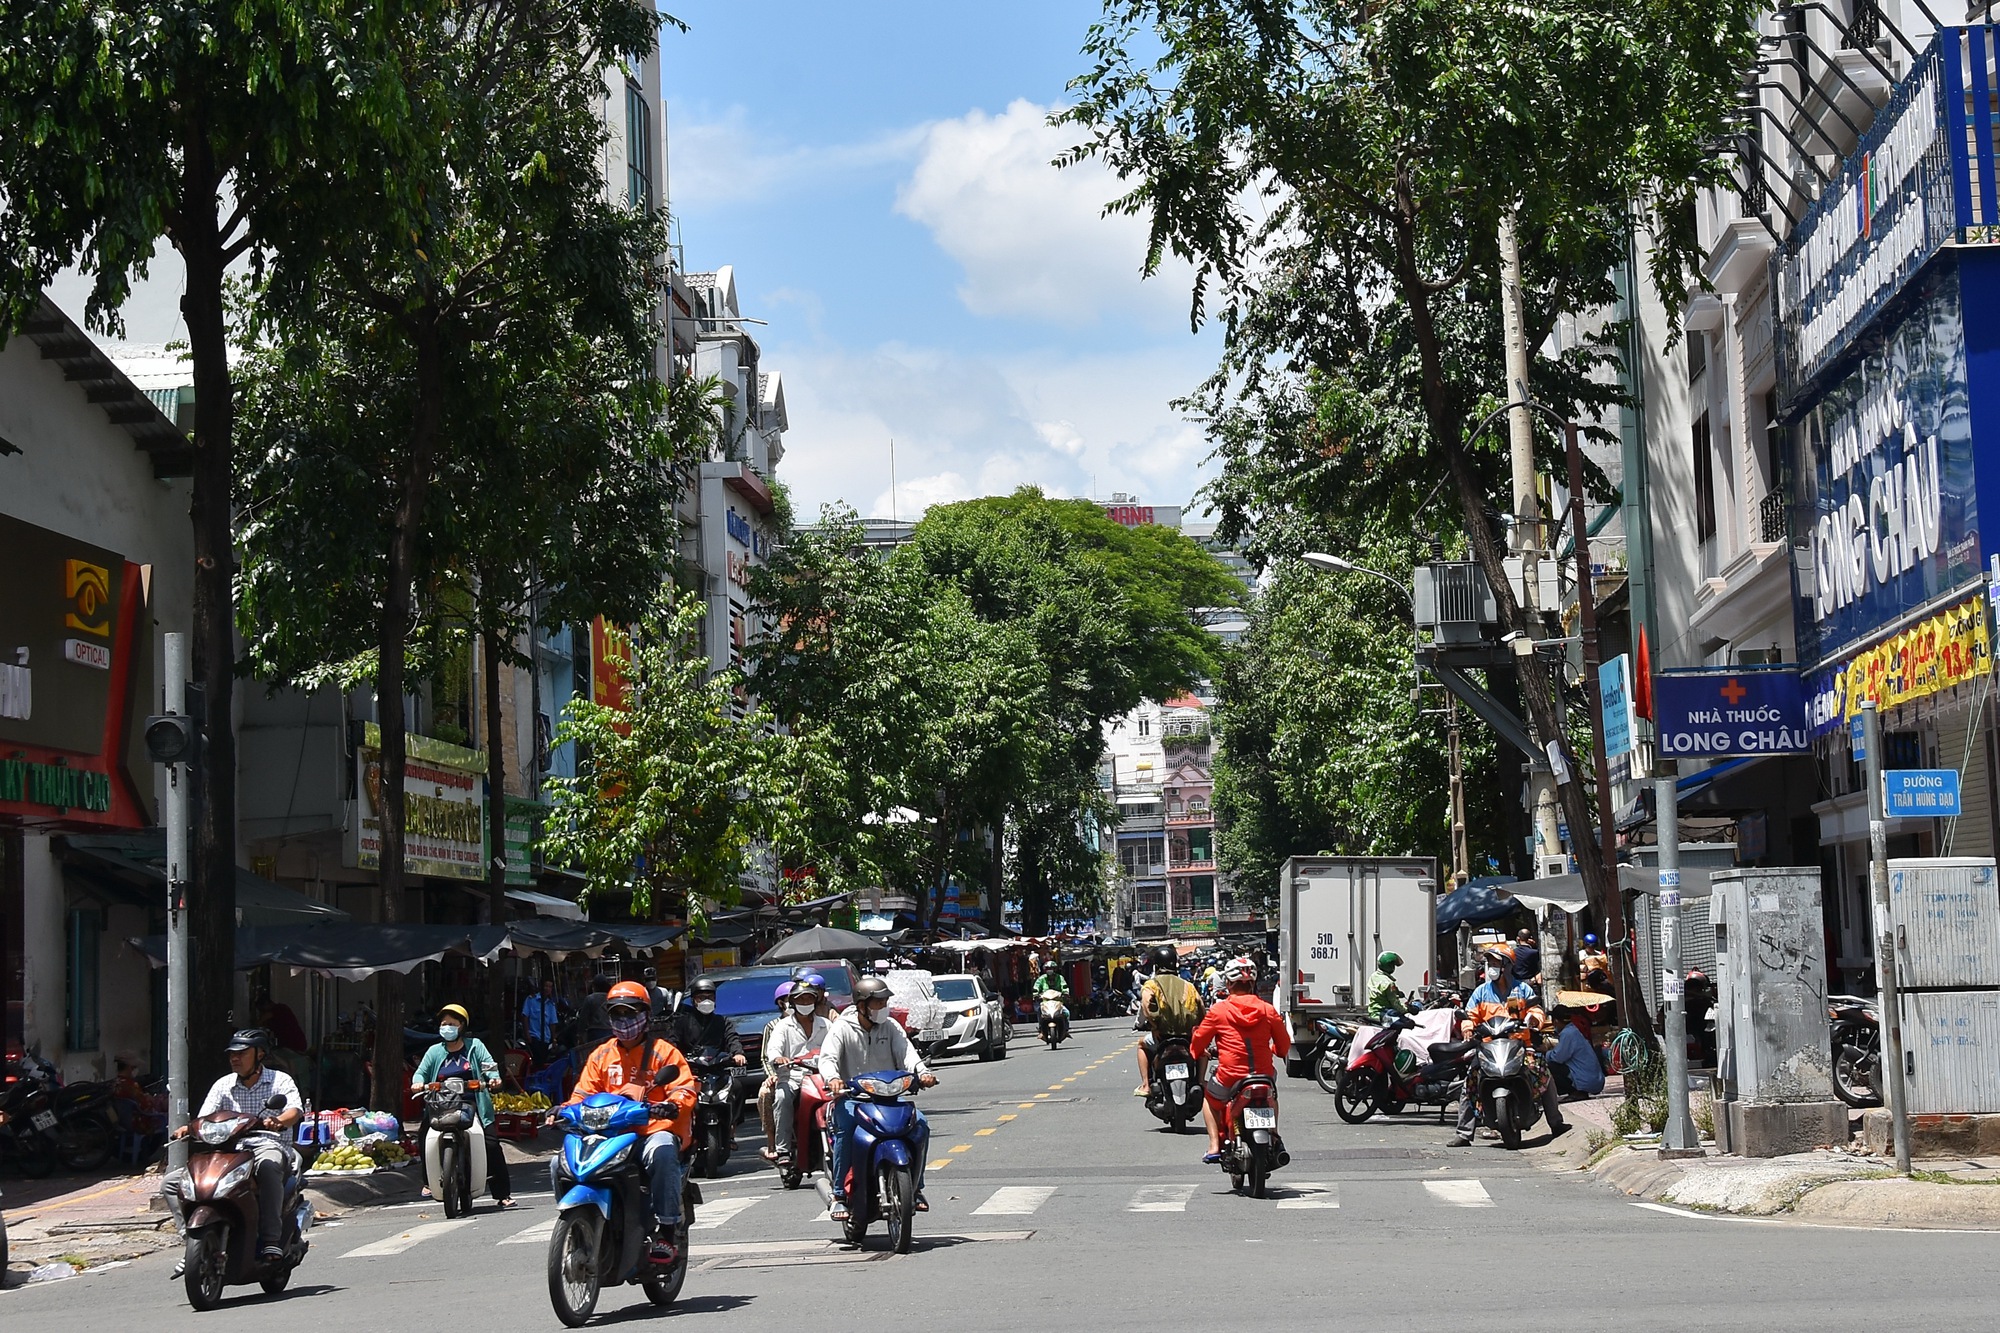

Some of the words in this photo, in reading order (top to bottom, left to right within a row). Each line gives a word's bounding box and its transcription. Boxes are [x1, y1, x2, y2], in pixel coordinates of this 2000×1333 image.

[1808, 493, 1867, 623] LONG
[1869, 421, 1941, 583] CHÂU
[76, 643, 107, 666] OPTICAL
[1689, 708, 1721, 723] NHÀ
[1726, 704, 1781, 723] THUỐC
[1662, 731, 1731, 752] LONG
[1738, 725, 1808, 751] CHÂU
[5, 751, 28, 801] KỸ
[31, 757, 79, 814] THUẬT
[83, 769, 111, 812] CAO
[1903, 775, 1942, 787] ĐƯỜNG
[1893, 789, 1913, 807] TRẦN
[1916, 792, 1936, 806] HƯNG
[1939, 792, 1954, 808] ĐẠO
[1317, 933, 1333, 945] 51D
[1310, 946, 1339, 960] 368.71
[1249, 1118, 1271, 1127] 9193
